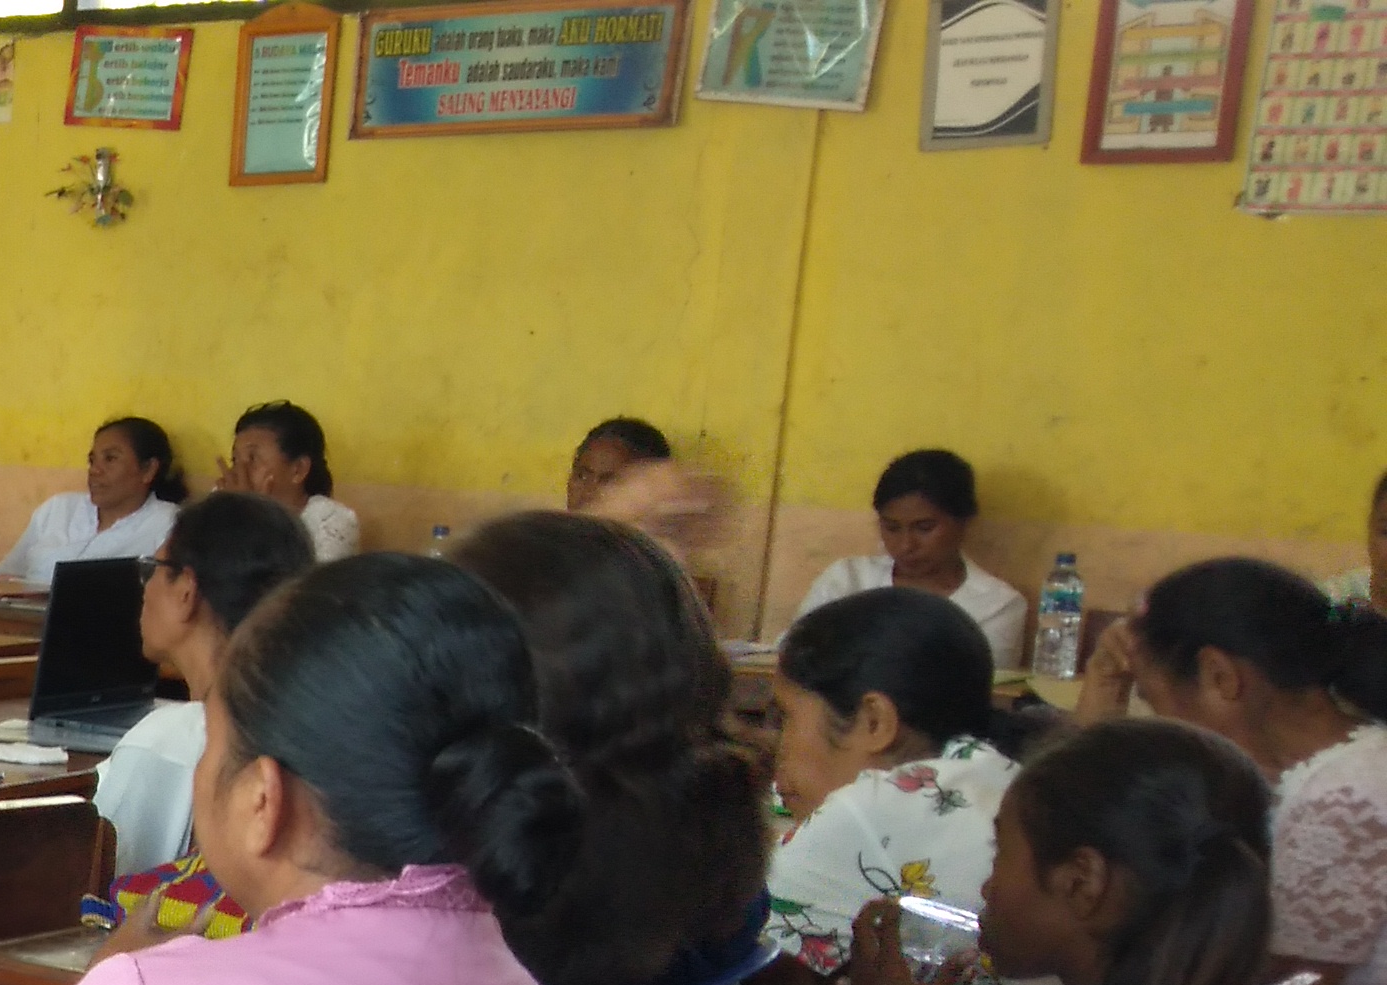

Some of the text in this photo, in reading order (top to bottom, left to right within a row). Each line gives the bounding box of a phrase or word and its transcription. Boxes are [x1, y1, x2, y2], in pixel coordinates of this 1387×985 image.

[375, 27, 432, 58] GURUKU
[528, 25, 555, 46] maka
[557, 16, 590, 46] AKU
[593, 12, 664, 44] HORMATI
[398, 58, 461, 89] Temanku
[467, 60, 500, 83] adalah
[560, 56, 590, 79] maka
[438, 87, 577, 118] SALING MENYAYANGI
